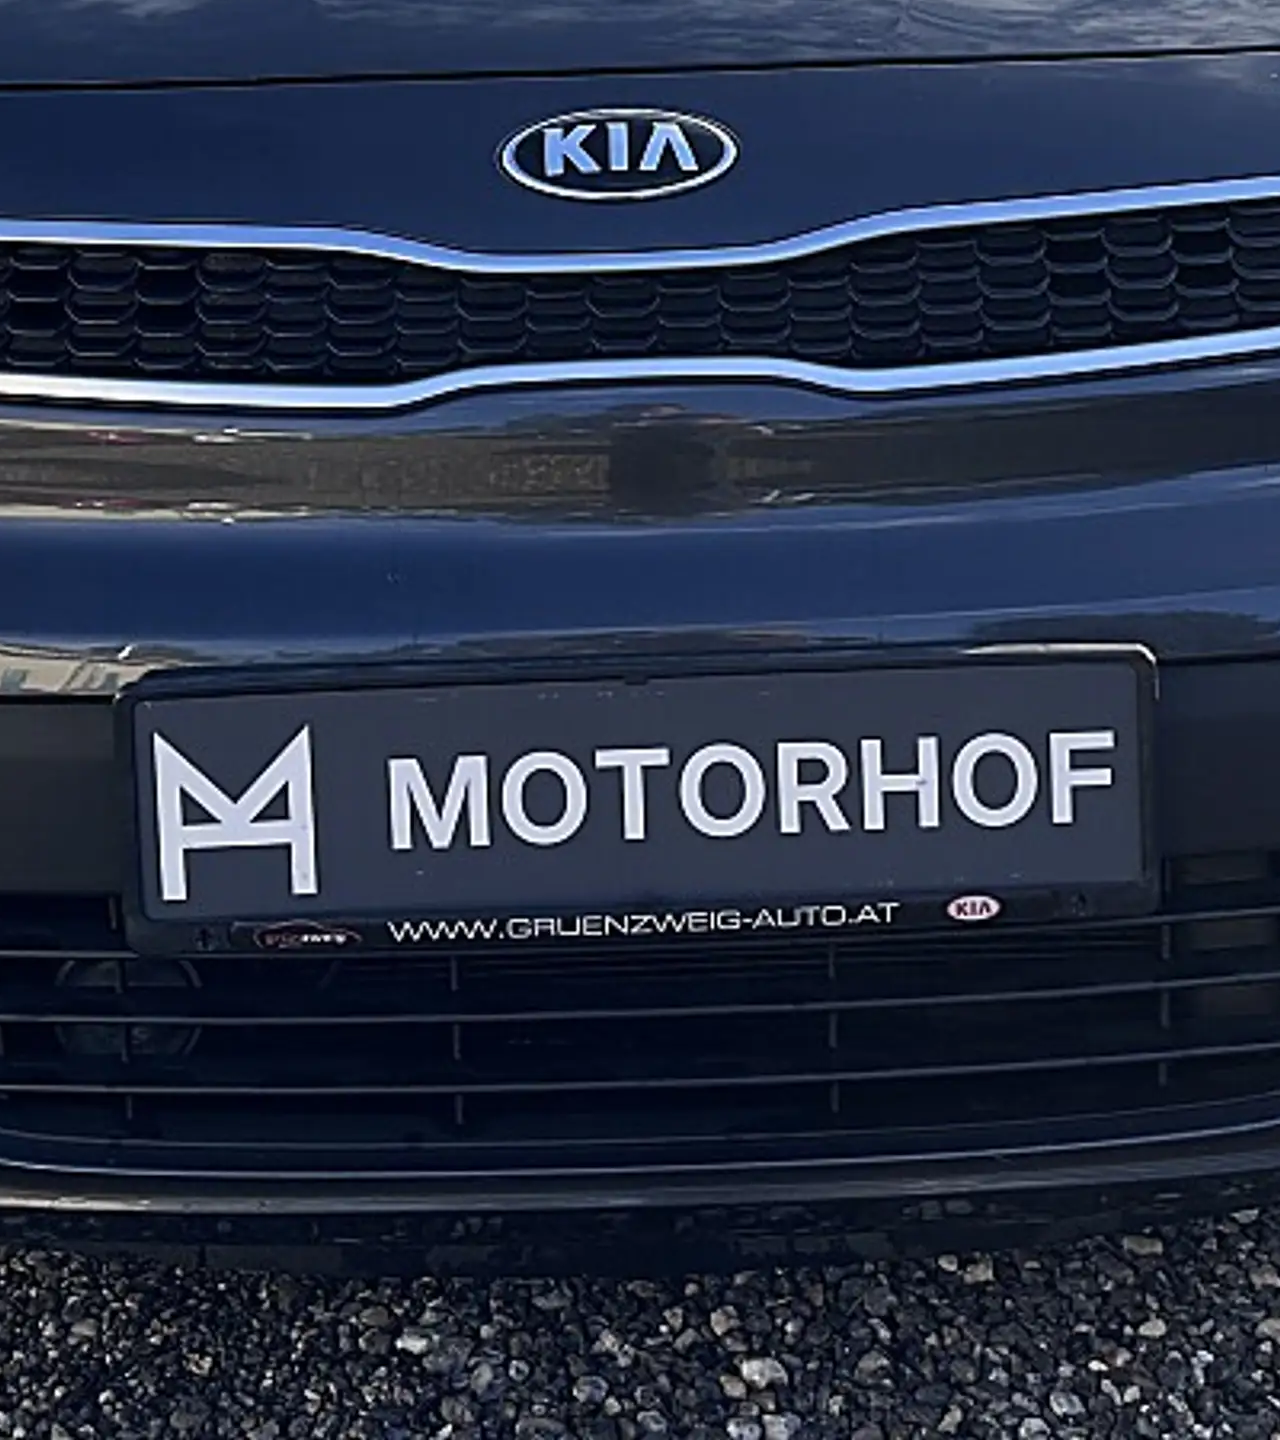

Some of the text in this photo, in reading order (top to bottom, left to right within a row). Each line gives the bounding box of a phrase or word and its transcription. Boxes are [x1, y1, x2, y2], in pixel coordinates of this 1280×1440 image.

[542, 120, 699, 178] KIA
[387, 730, 1116, 851] MOTORHOF
[386, 901, 901, 943] WWW.GRUENZWEIG-AUTO.AT
